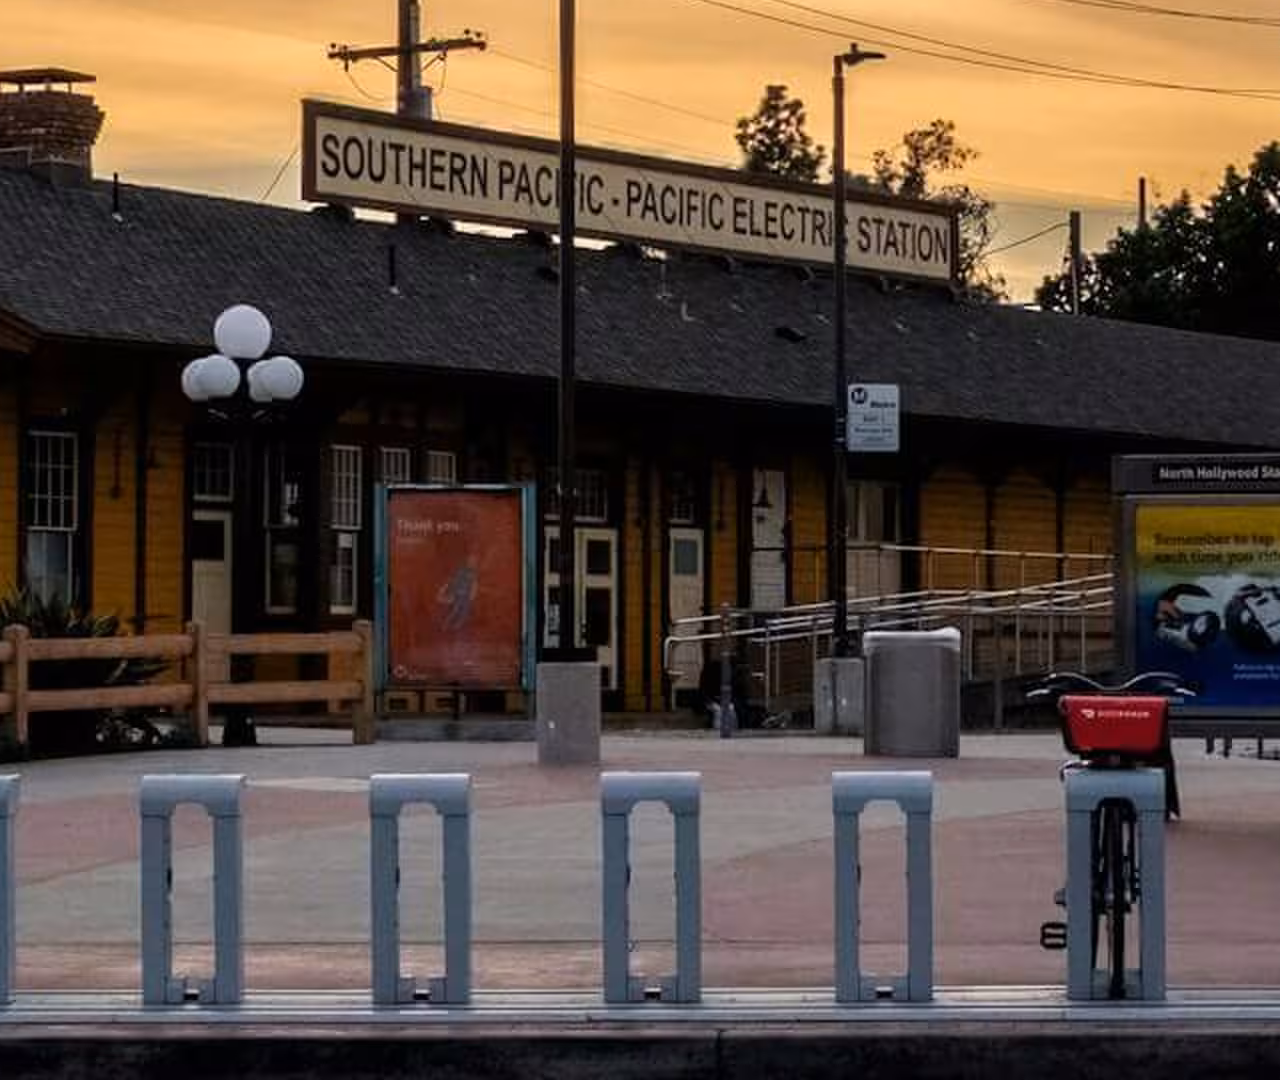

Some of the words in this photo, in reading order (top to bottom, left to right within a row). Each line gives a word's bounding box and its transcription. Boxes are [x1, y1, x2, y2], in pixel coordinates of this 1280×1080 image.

[321, 132, 489, 198] SOUTHERN
[498, 158, 605, 216] PACIIC
[626, 178, 725, 231] PACIFIC
[857, 214, 948, 266] STATION
[1159, 465, 1195, 479] North
[1197, 464, 1259, 481] Hollywood
